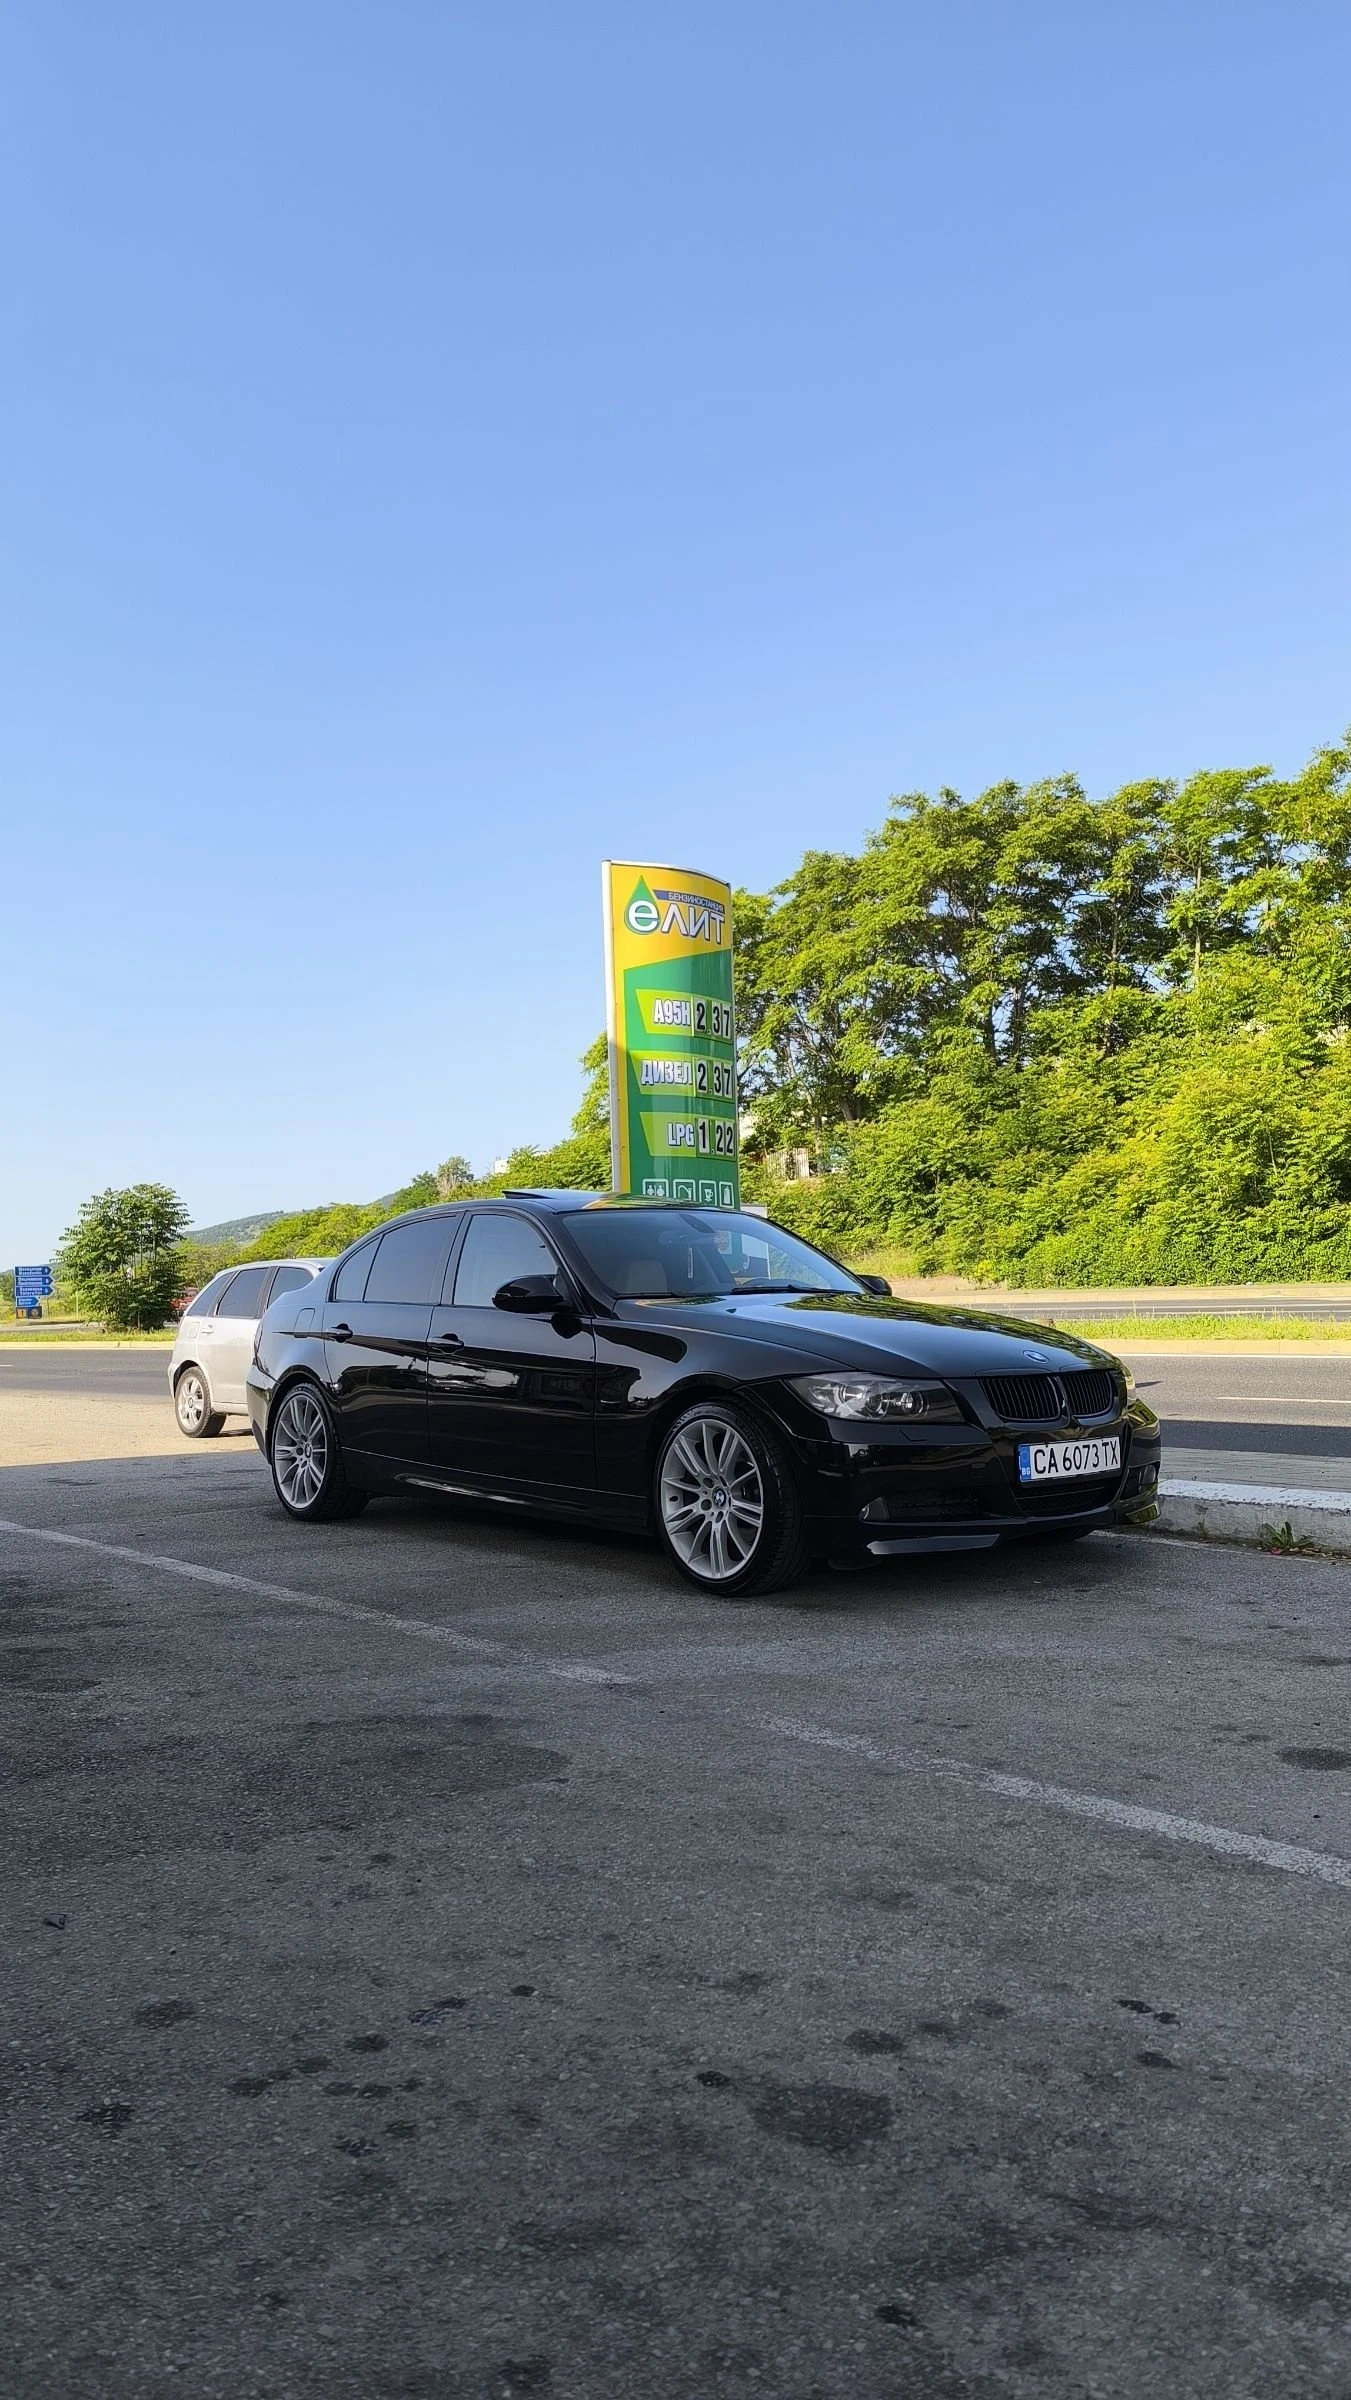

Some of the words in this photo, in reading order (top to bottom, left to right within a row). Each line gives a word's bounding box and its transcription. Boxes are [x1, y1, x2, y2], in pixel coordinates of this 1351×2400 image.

[696, 1002, 730, 1037] 2.37
[641, 1060, 693, 1086] ДИЗЕЛ
[697, 1063, 731, 1095] 2.37
[667, 1122, 695, 1147] LPG
[699, 1121, 734, 1154] 1.22
[1021, 1467, 1031, 1475] BG
